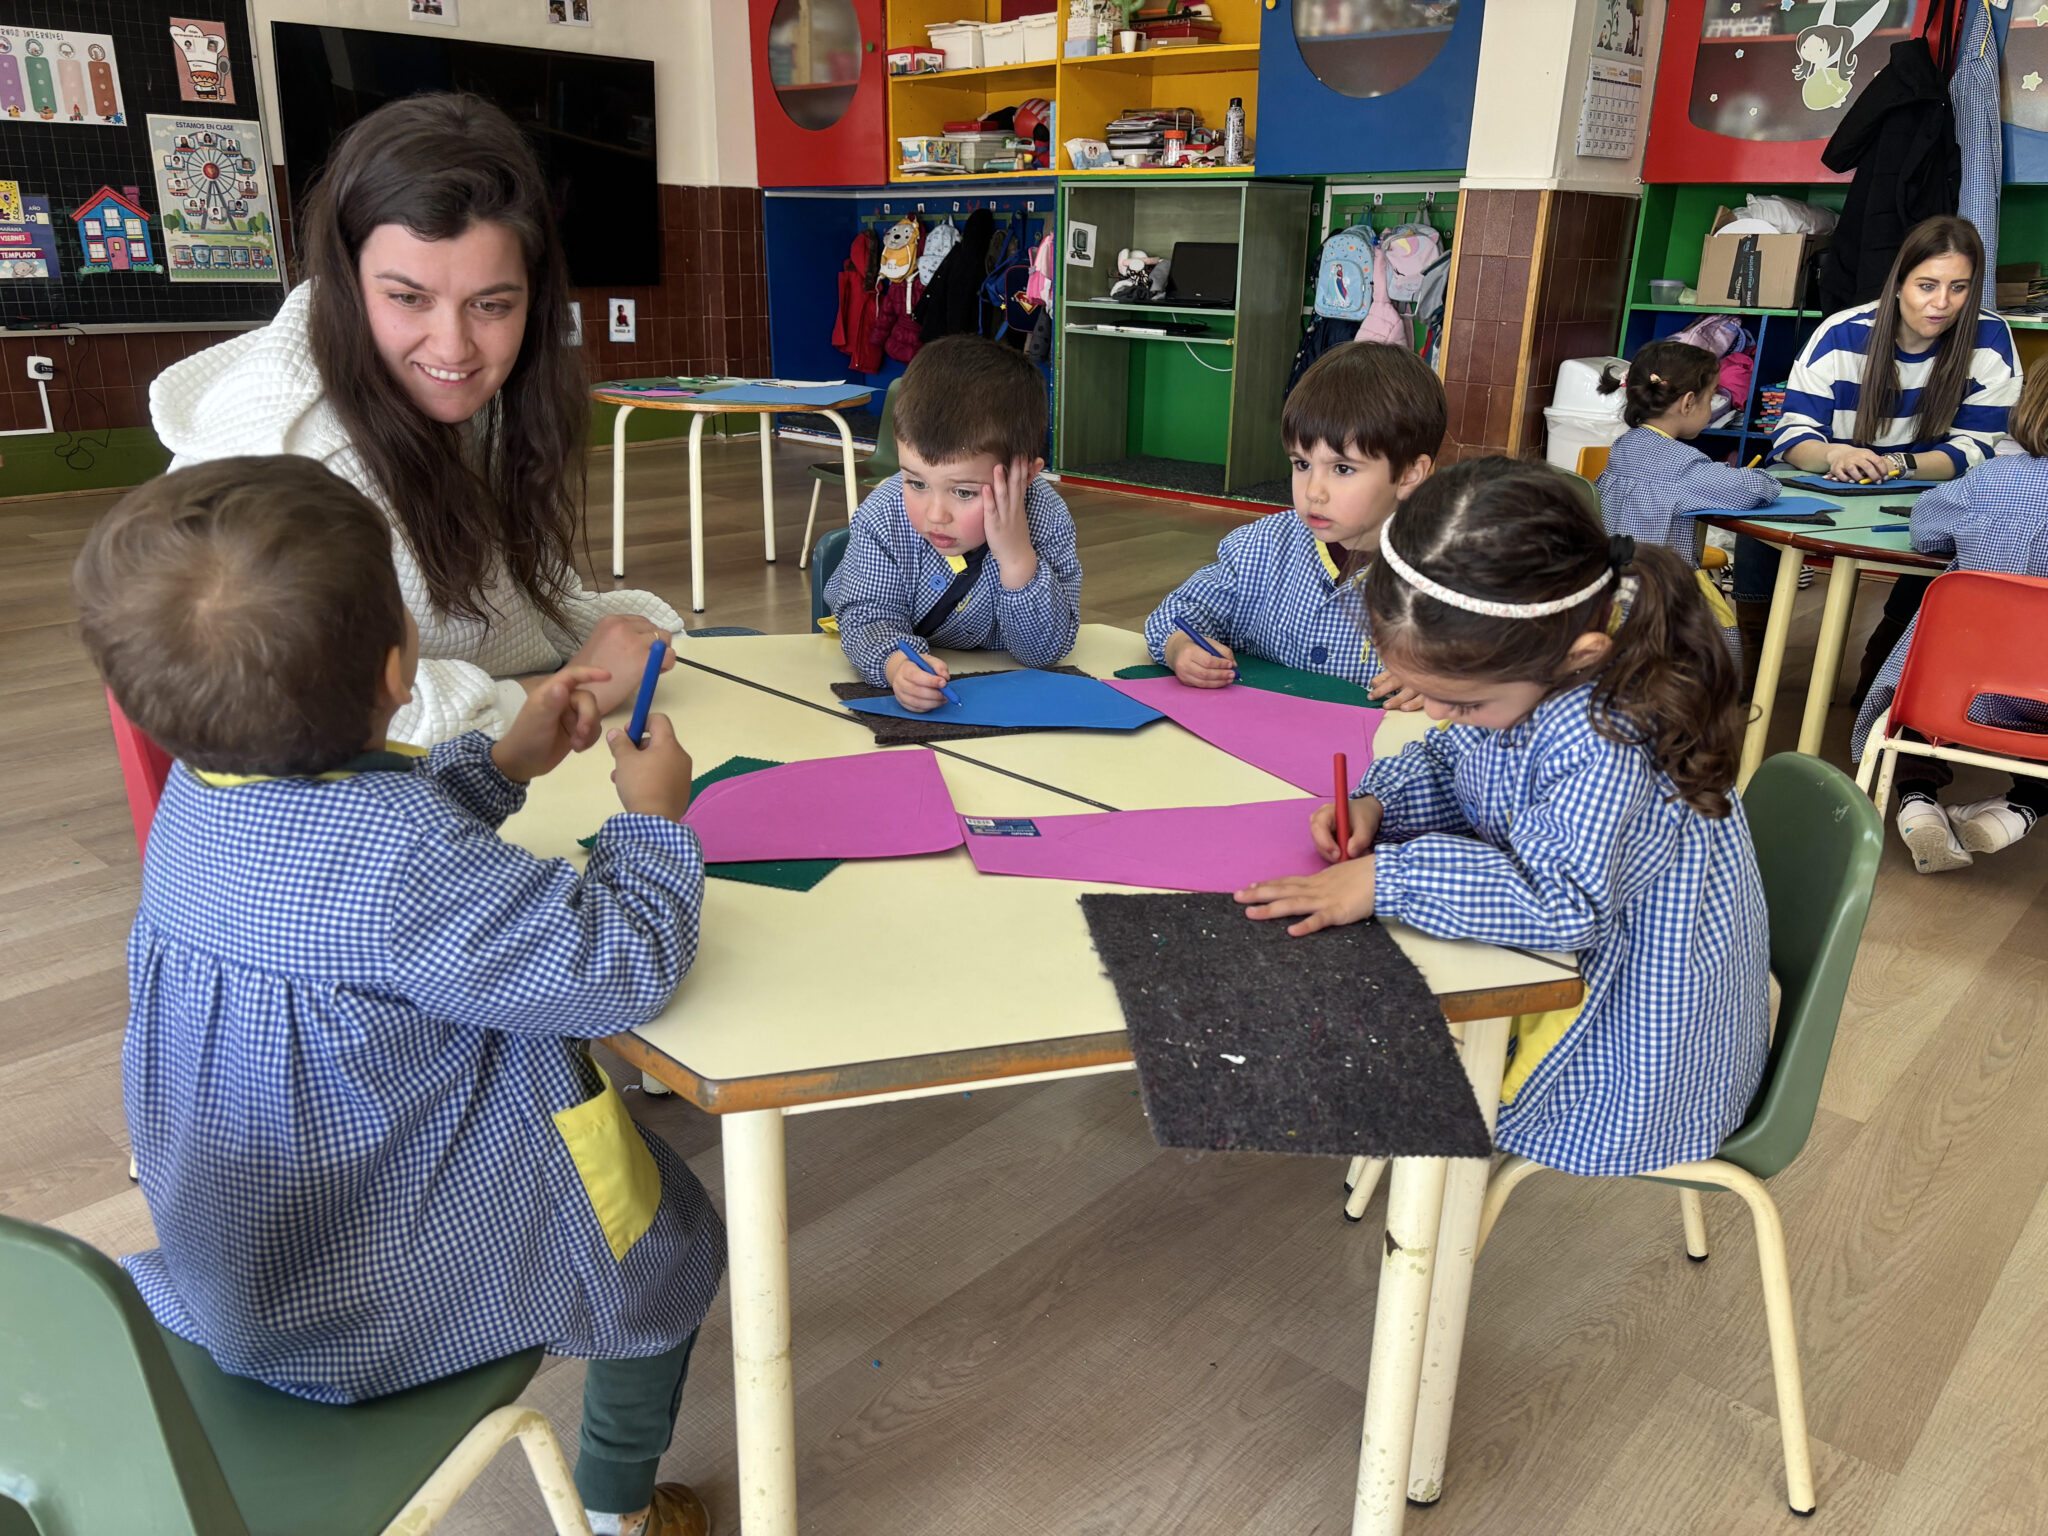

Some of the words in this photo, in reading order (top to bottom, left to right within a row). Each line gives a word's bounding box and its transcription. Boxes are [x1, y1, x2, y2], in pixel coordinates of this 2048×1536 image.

[176, 121, 205, 129] ESTAMOS
[25, 214, 37, 222] 20
[0, 251, 36, 259] TEMPLADO
[1904, 794, 1925, 804] adidas
[2021, 807, 2034, 826] adidas
